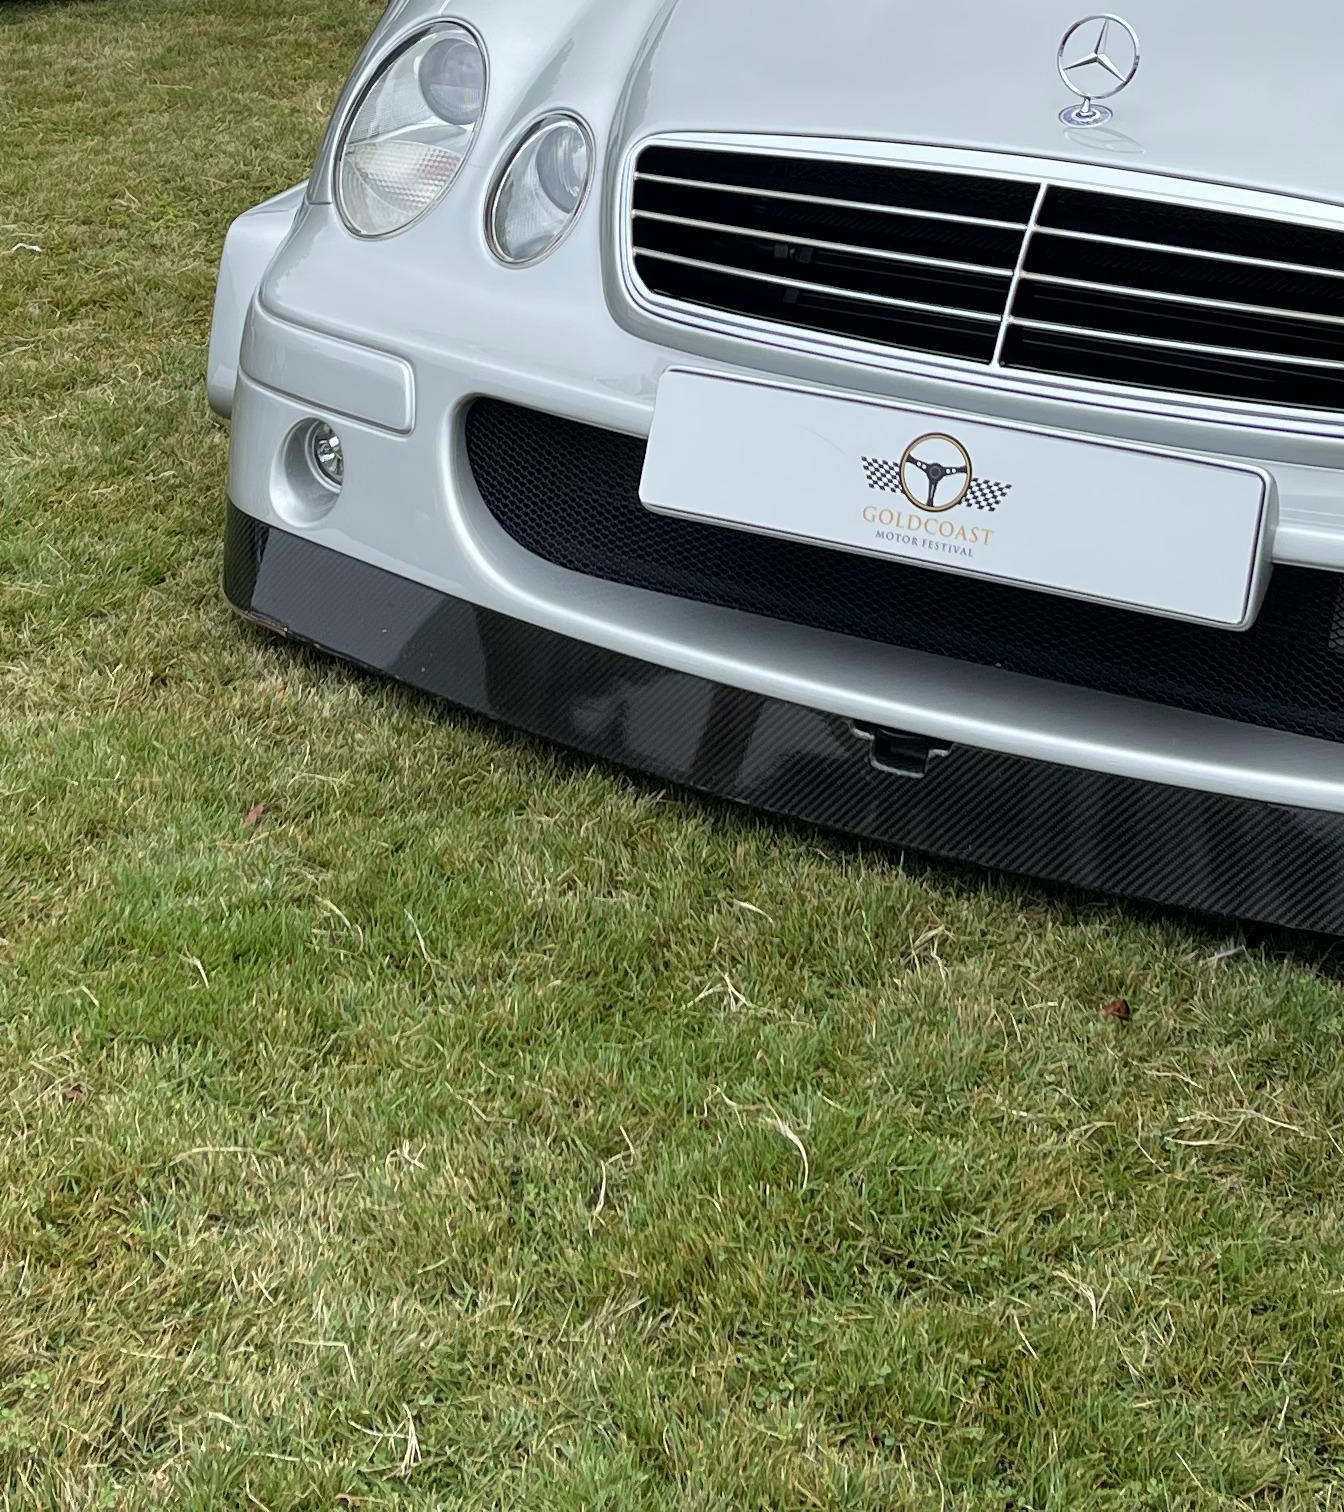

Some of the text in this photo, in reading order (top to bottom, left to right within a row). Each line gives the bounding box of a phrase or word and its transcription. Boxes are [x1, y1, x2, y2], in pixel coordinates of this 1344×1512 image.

[862, 505, 995, 546] GOLDCOAST
[875, 530, 974, 558] MOTOR FESTIVAL
